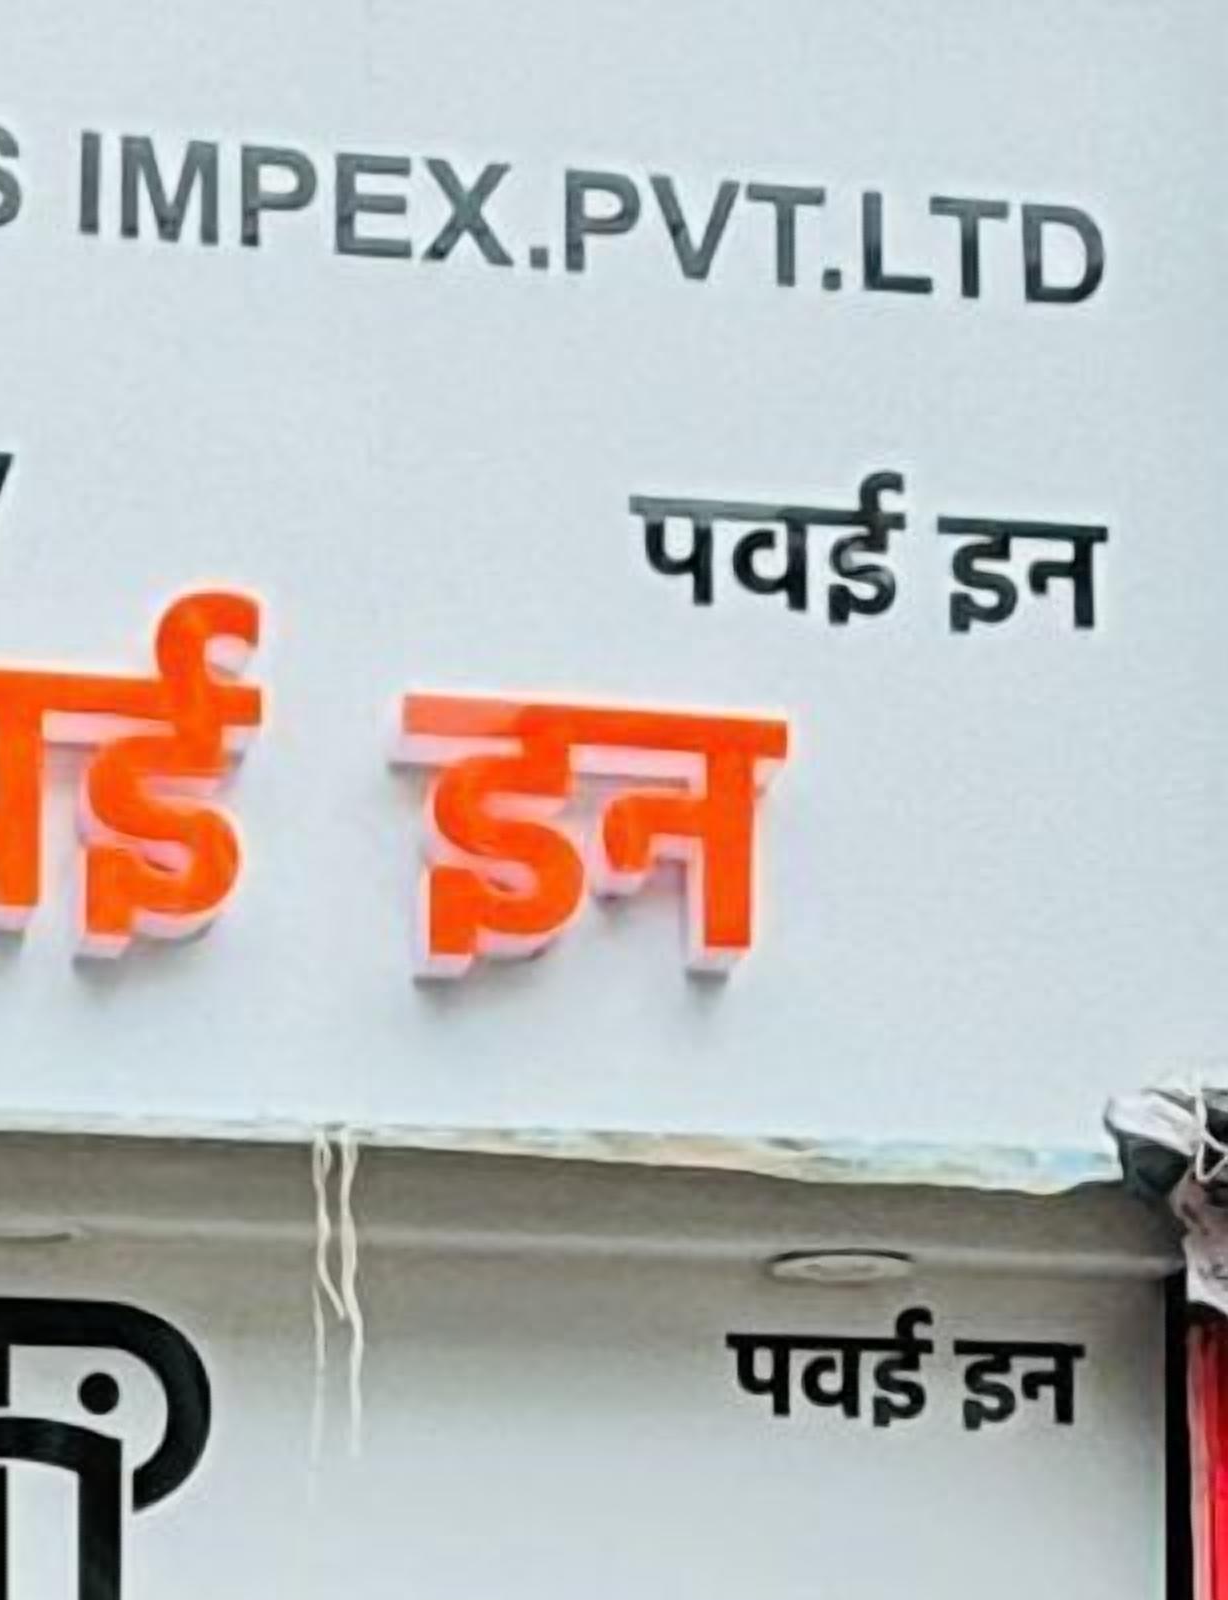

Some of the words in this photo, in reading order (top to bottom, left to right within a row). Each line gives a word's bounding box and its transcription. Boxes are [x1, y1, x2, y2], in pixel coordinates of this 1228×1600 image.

[628, 470, 908, 627] पवई
[935, 515, 1110, 635] इन
[402, 694, 790, 975] इन
[725, 1306, 934, 1427] पवई
[952, 1338, 1086, 1431] इन
